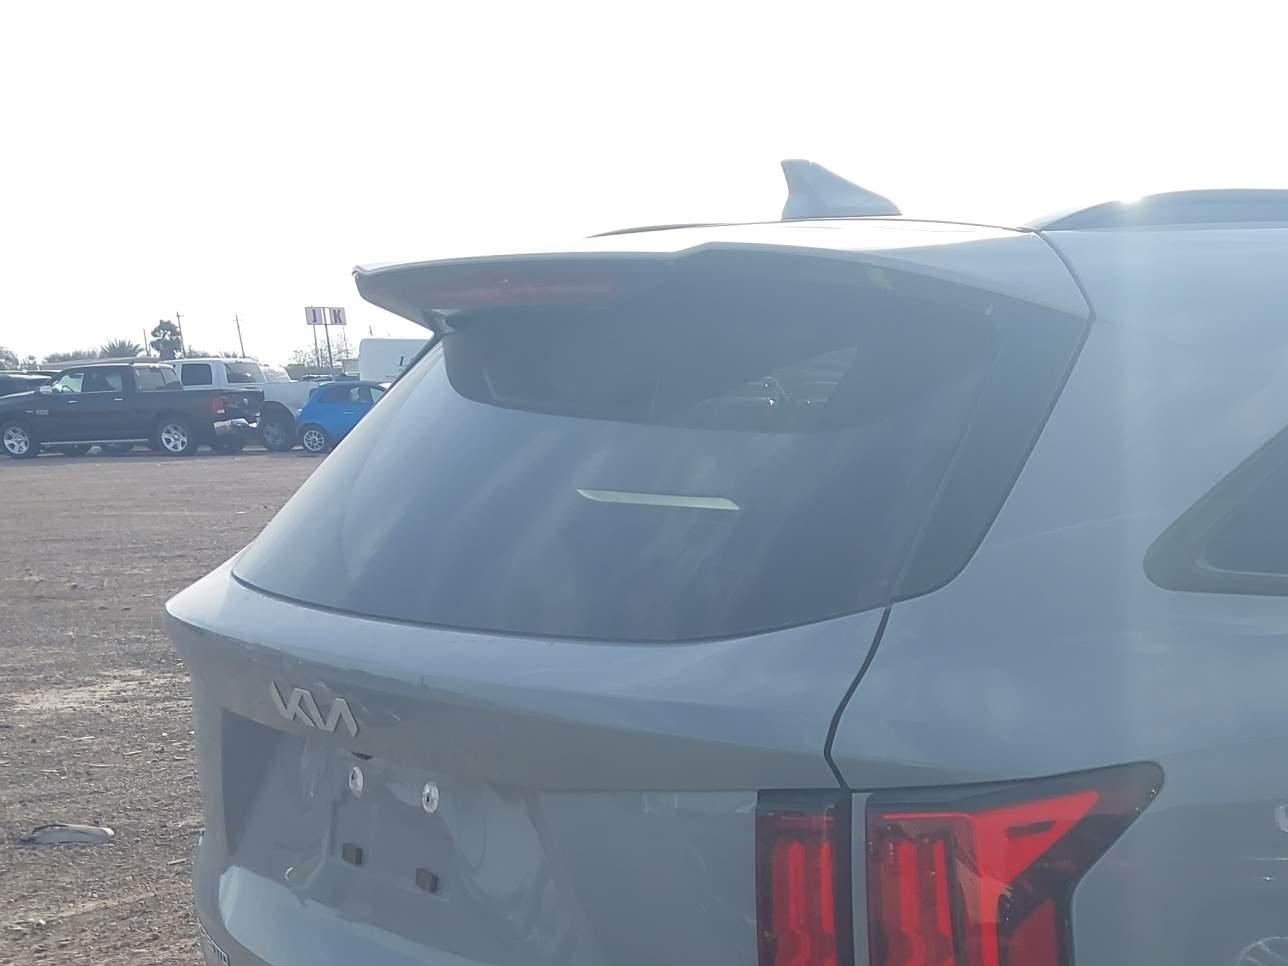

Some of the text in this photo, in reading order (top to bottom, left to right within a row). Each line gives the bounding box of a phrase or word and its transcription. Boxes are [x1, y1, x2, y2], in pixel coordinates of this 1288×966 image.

[311, 308, 343, 324] J K
[271, 679, 360, 738] KIA
